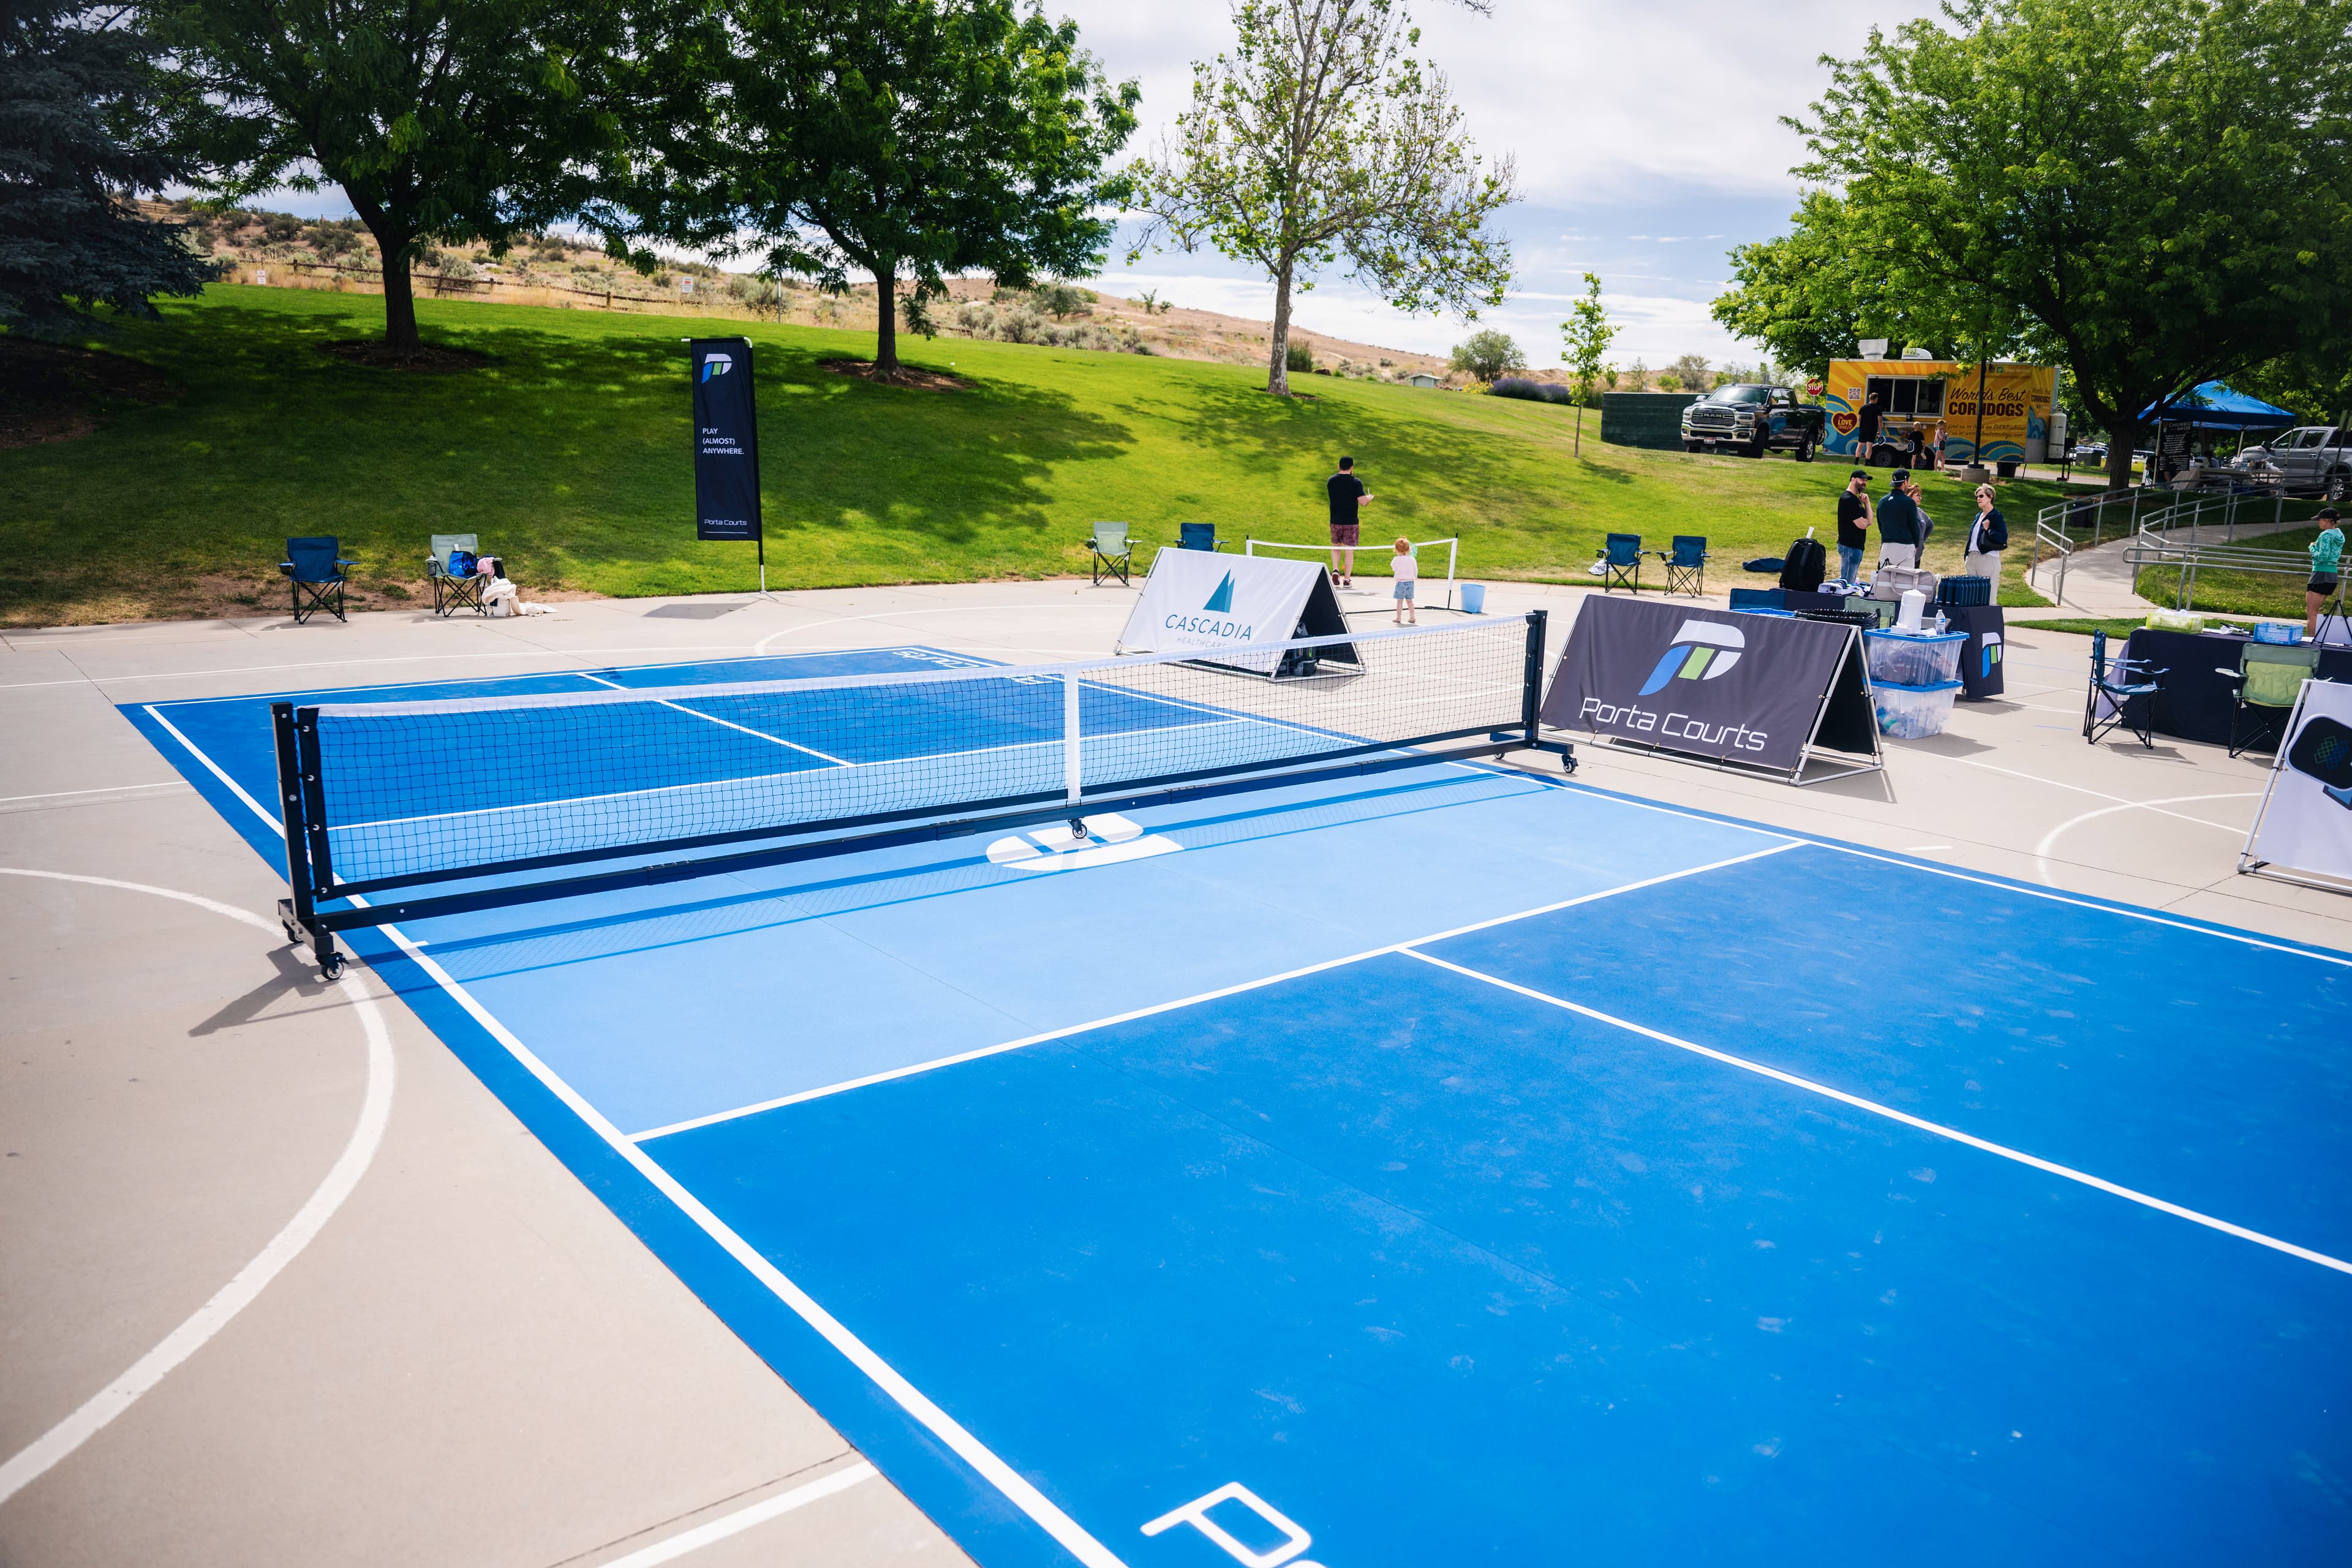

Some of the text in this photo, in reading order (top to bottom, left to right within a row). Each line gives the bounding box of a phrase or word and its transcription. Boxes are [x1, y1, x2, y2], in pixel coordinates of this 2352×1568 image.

[1998, 388, 2026, 402] Best
[1166, 614, 1251, 641] CASCADIA
[1579, 697, 1768, 752] Porta Courts
